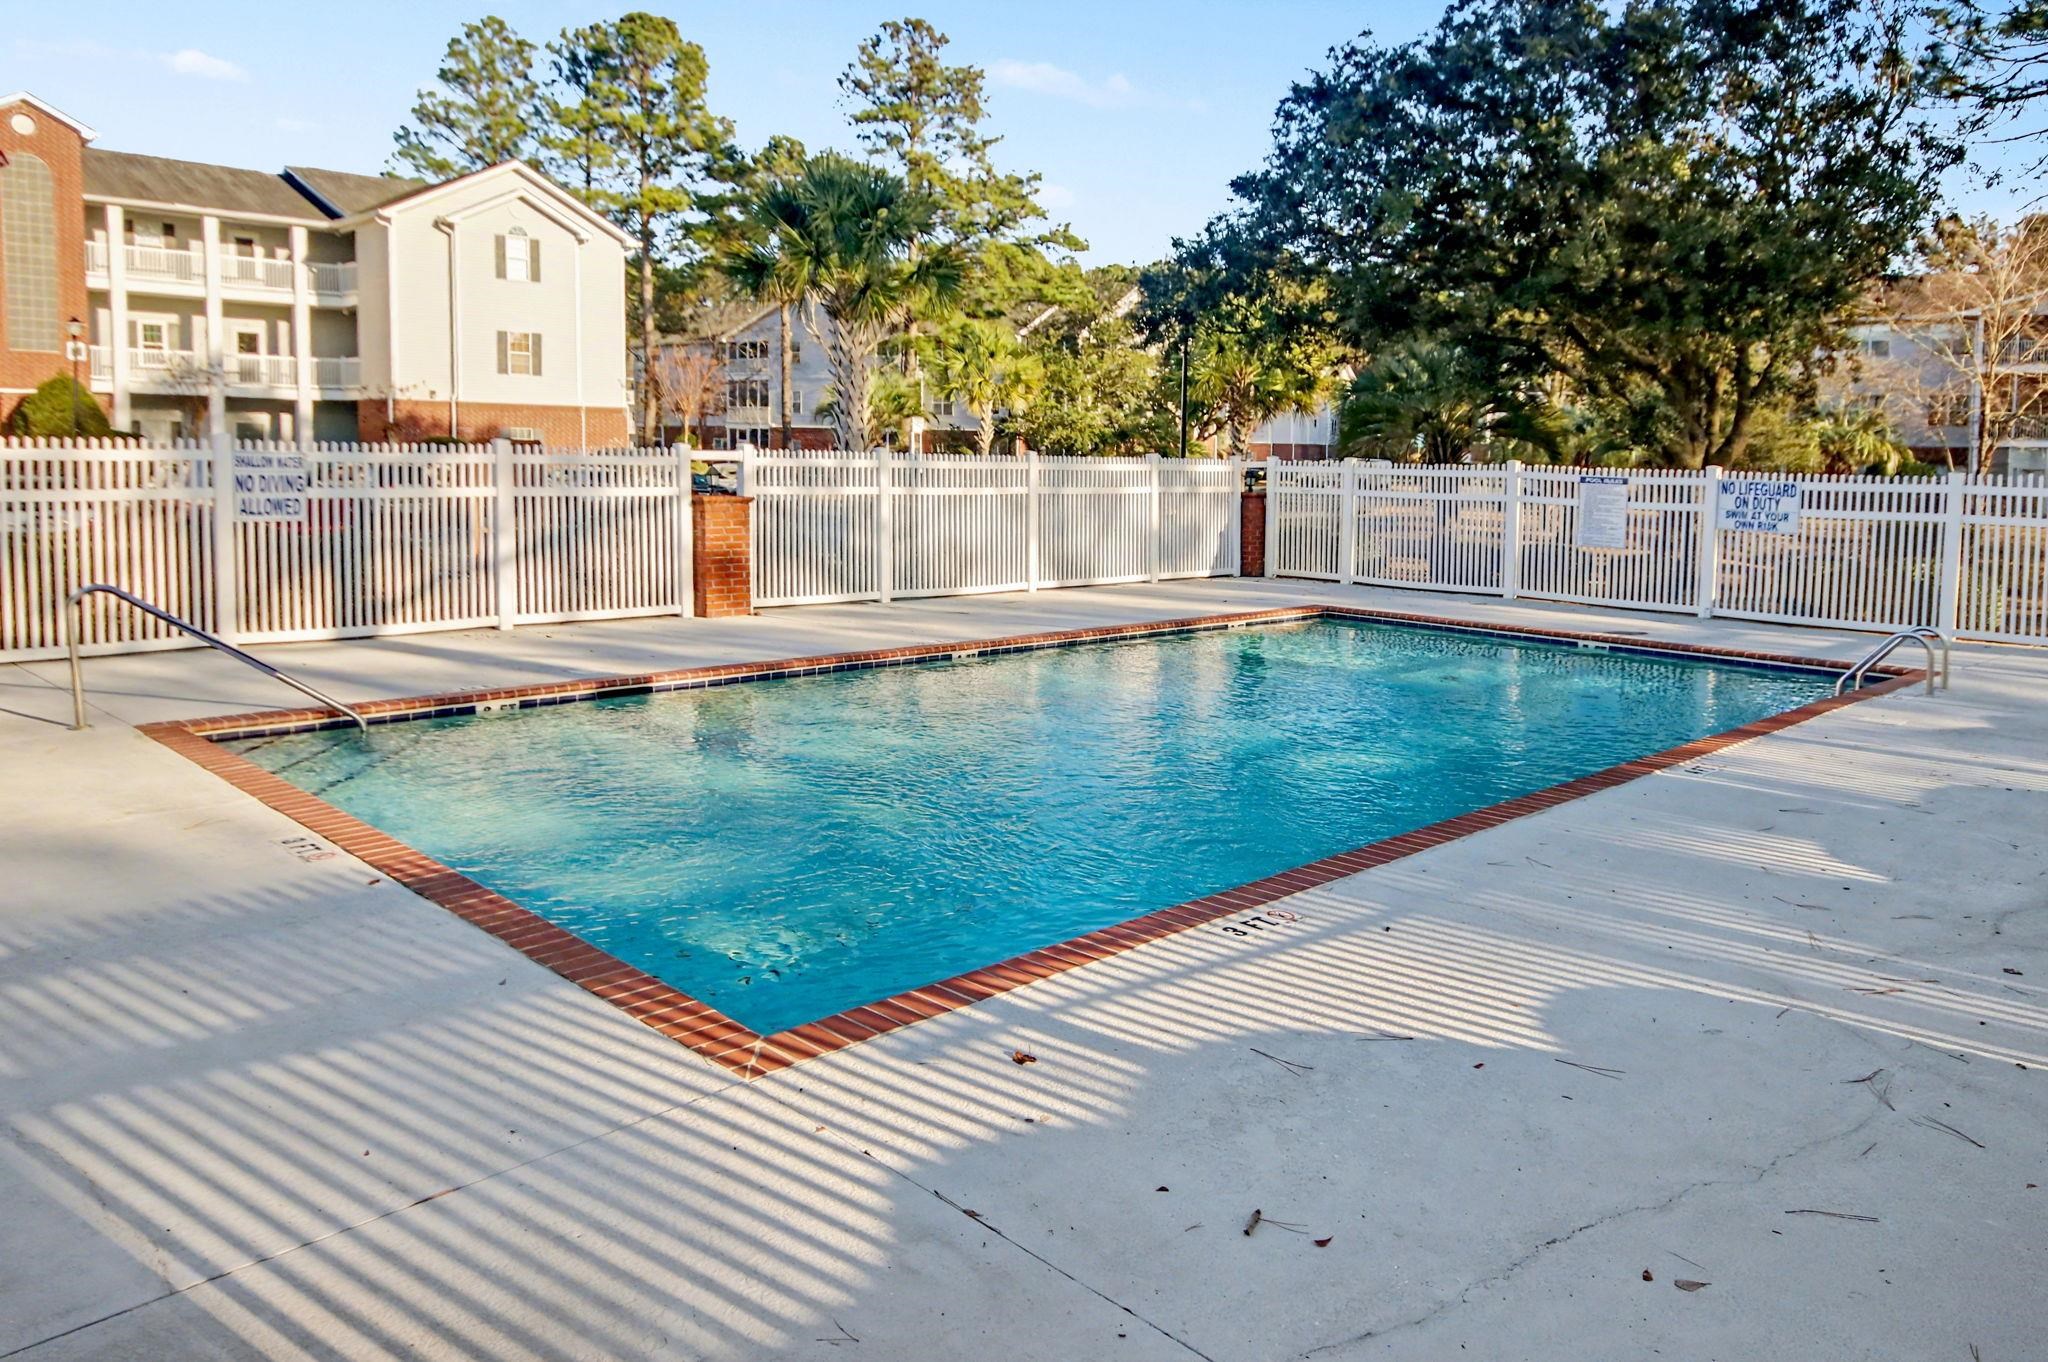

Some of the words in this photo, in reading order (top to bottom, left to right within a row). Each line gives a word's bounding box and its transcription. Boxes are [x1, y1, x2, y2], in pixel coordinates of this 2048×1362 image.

[235, 475, 255, 493] NO
[259, 475, 305, 493] DIVING
[1721, 482, 1735, 494] NO
[1739, 482, 1797, 498] LIFEGUARD
[240, 498, 301, 516] ALLOWED
[1734, 496, 1748, 509] ON
[1753, 497, 1780, 511] DUTY
[1725, 510, 1747, 519] SWIM
[1751, 512, 1761, 520] AT
[1765, 512, 1789, 522] YOUR
[1734, 520, 1754, 530] OWN
[1757, 521, 1778, 531] RISK
[1222, 926, 1248, 937] 3
[1240, 916, 1280, 931] FT
